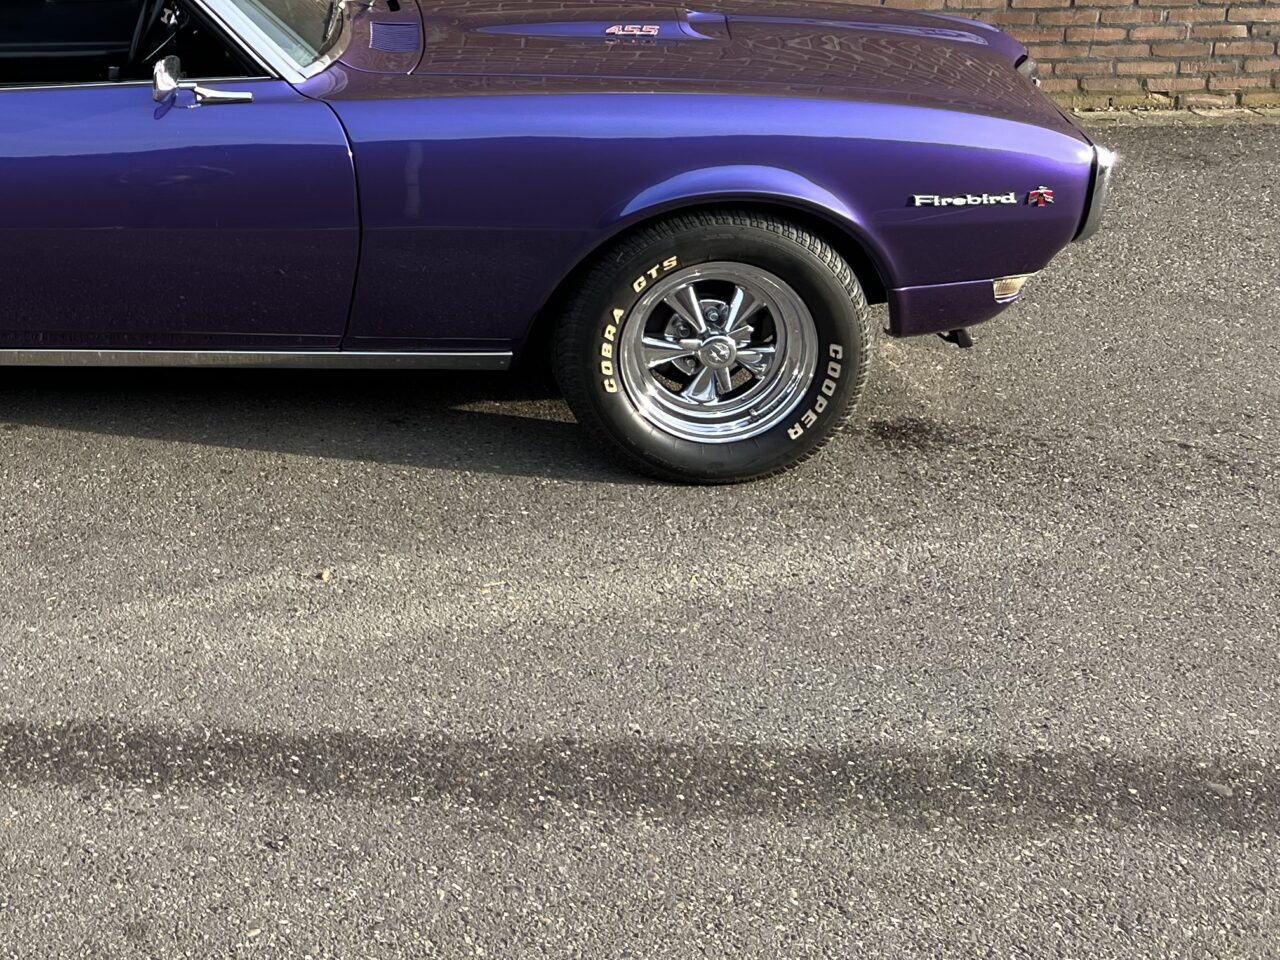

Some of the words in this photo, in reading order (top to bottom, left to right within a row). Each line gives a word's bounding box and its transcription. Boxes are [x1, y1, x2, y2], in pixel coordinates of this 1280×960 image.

[605, 24, 660, 36] 455
[912, 192, 1017, 207] Firebird
[600, 307, 625, 393] COBRA
[632, 255, 679, 293] GTS
[787, 343, 844, 441] COOPER
